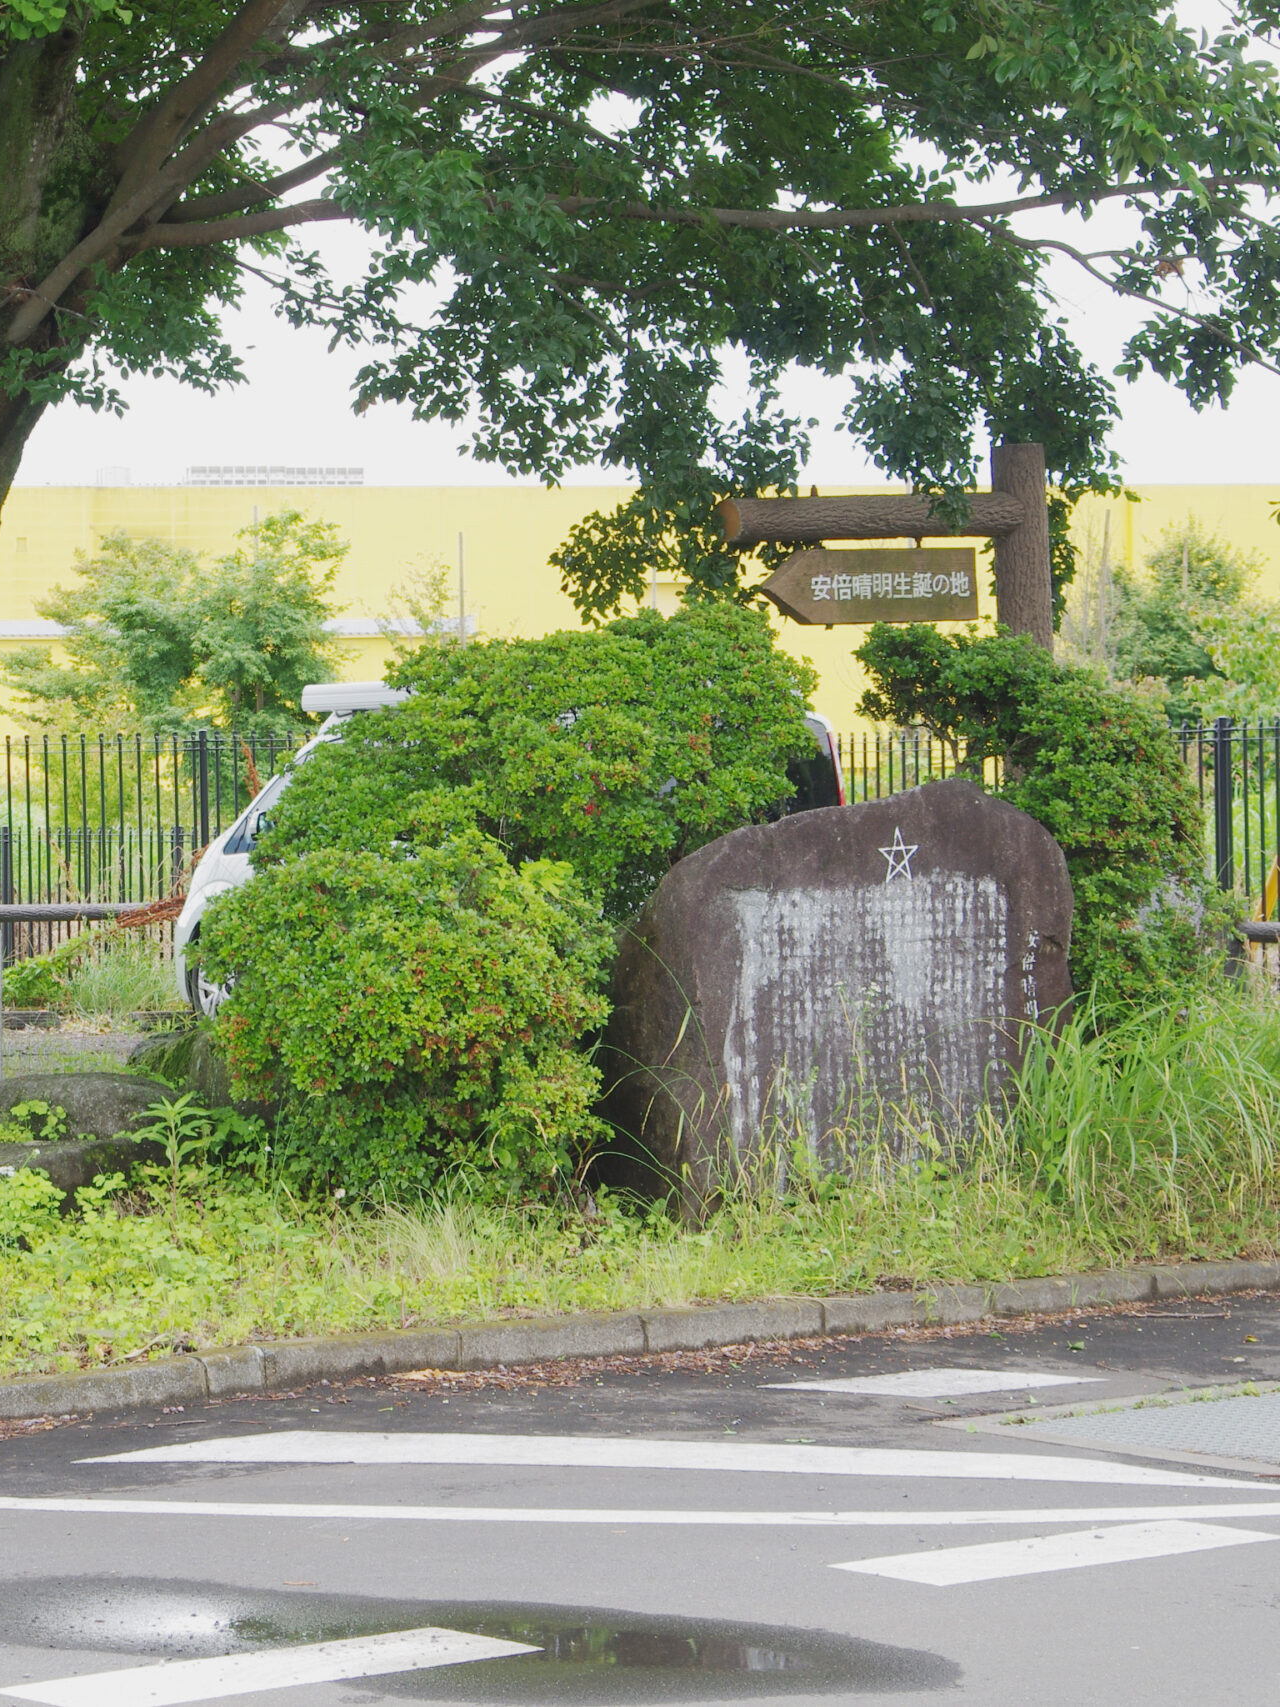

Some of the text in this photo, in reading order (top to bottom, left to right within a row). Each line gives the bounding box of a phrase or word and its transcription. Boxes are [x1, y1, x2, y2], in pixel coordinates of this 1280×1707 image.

[811, 571, 970, 601] 安倍晴明生誕の地
